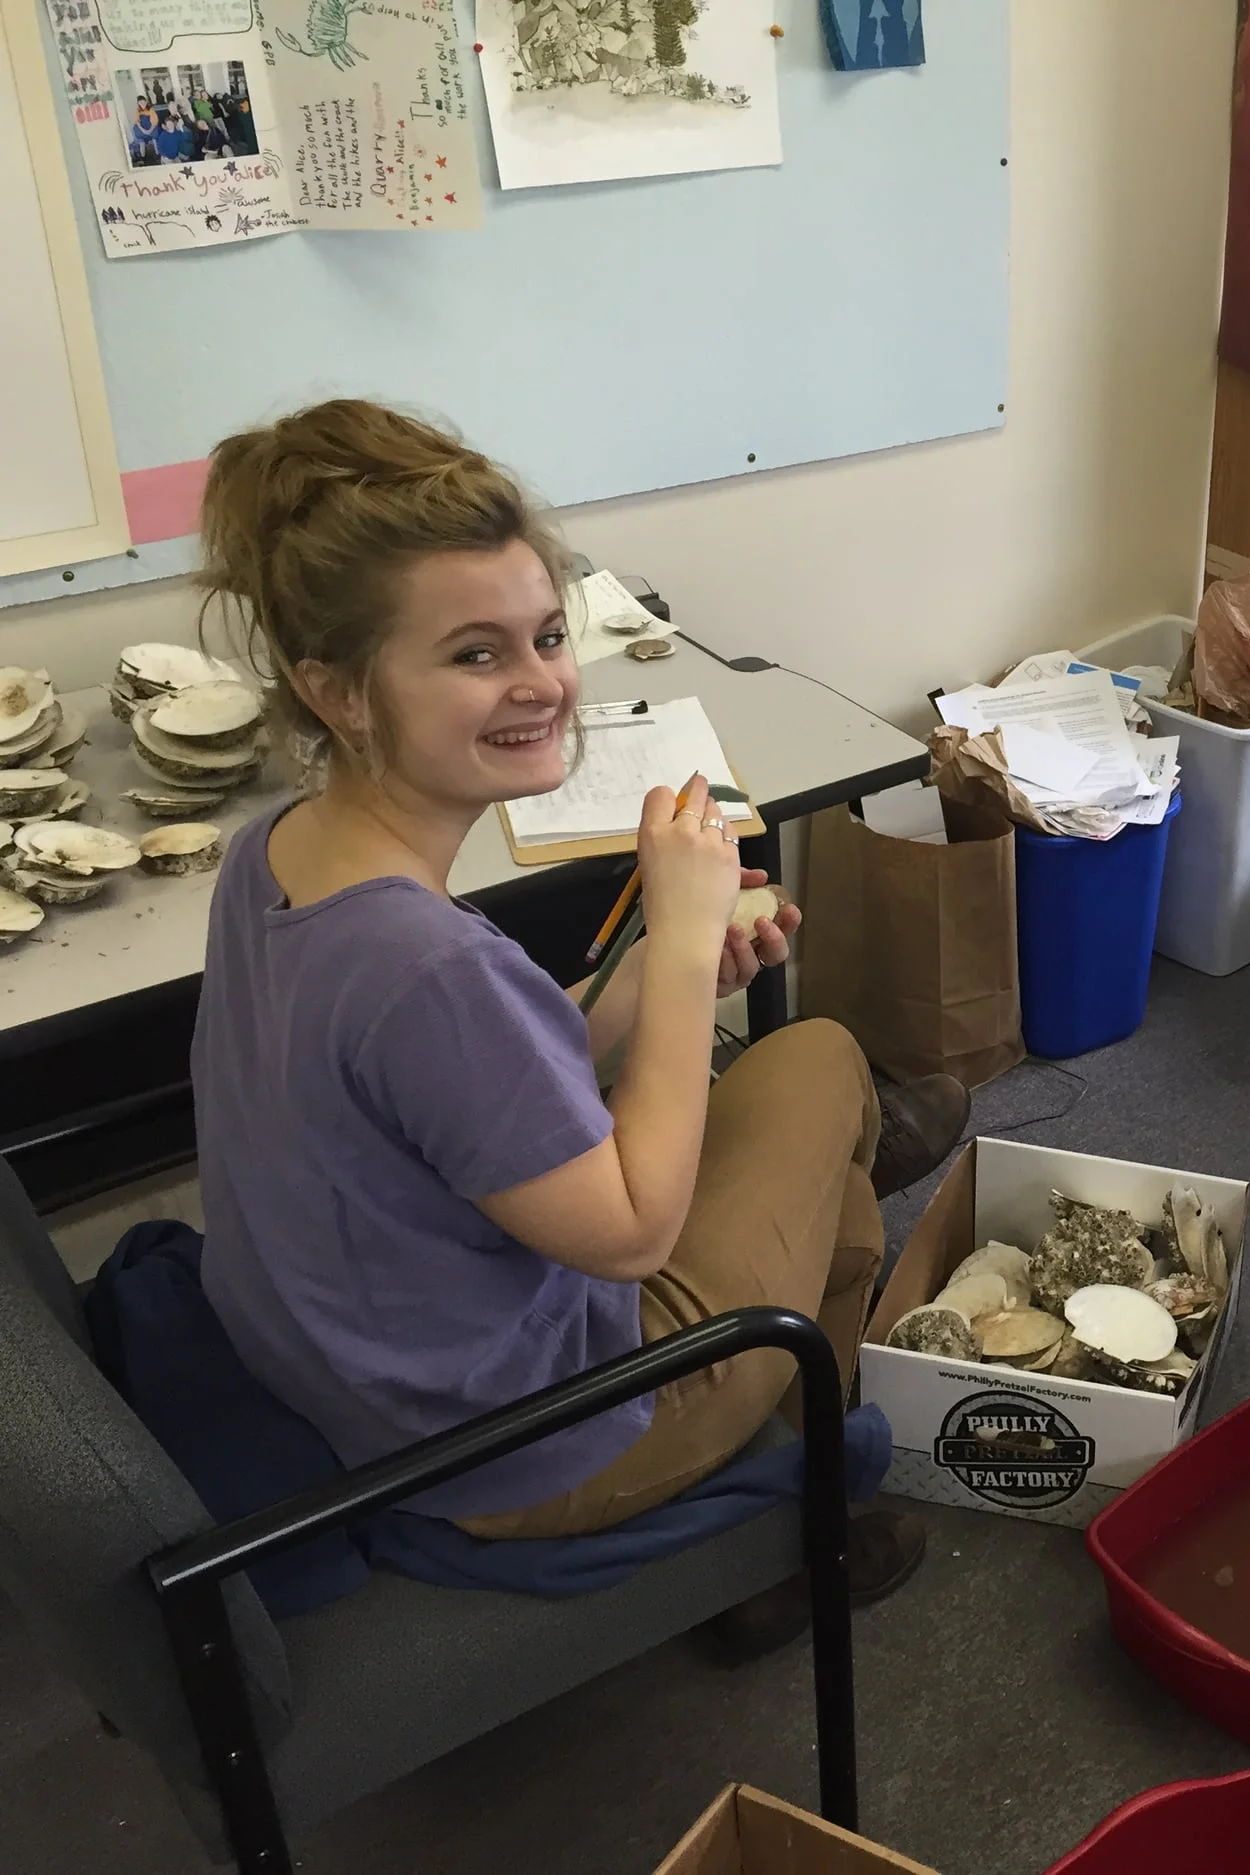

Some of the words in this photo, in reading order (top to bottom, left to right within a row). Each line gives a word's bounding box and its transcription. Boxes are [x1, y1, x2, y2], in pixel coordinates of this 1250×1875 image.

[410, 68, 433, 120] Thanks
[308, 137, 318, 149] so
[311, 153, 323, 172] you
[327, 152, 337, 168] the
[370, 133, 386, 196] Quarry
[328, 174, 338, 188] all
[352, 171, 361, 186] the
[299, 180, 312, 205] Dear
[938, 1369, 1092, 1404] www.PhillyPretzelFactory.com
[966, 1415, 1052, 1433] PHILLY
[971, 1470, 1075, 1488] FACTORY
